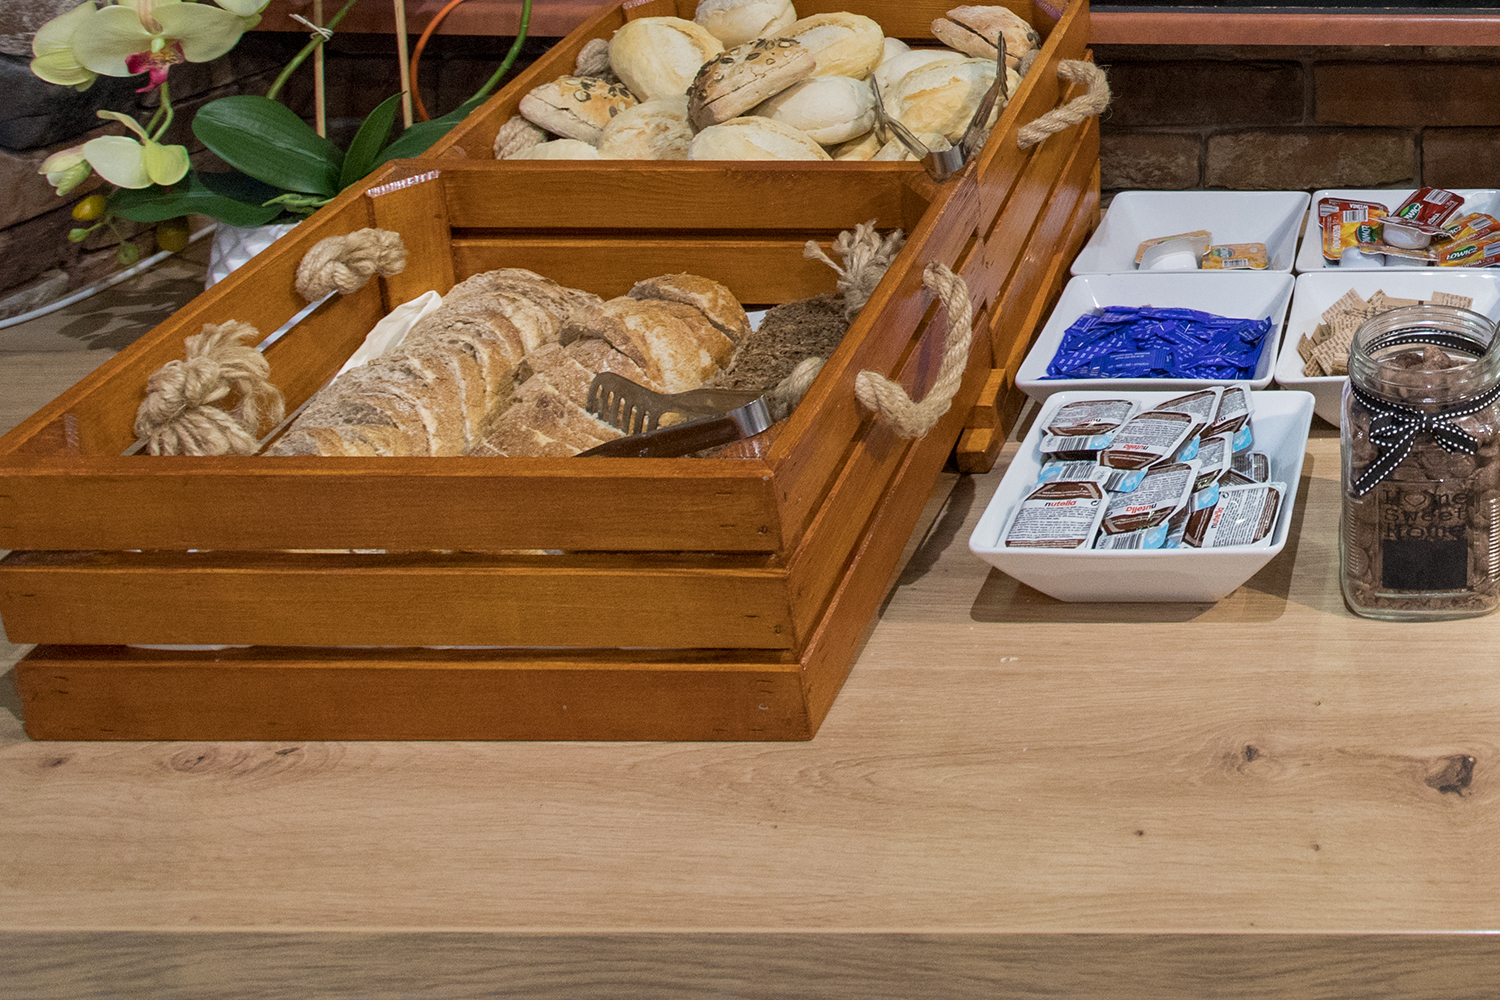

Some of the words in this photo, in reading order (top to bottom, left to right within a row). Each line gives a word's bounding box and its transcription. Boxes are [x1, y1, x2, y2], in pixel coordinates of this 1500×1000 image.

[1446, 245, 1478, 260] ŁOWICZ
[1126, 503, 1157, 513] nutella
[1385, 507, 1469, 522] Sweet
